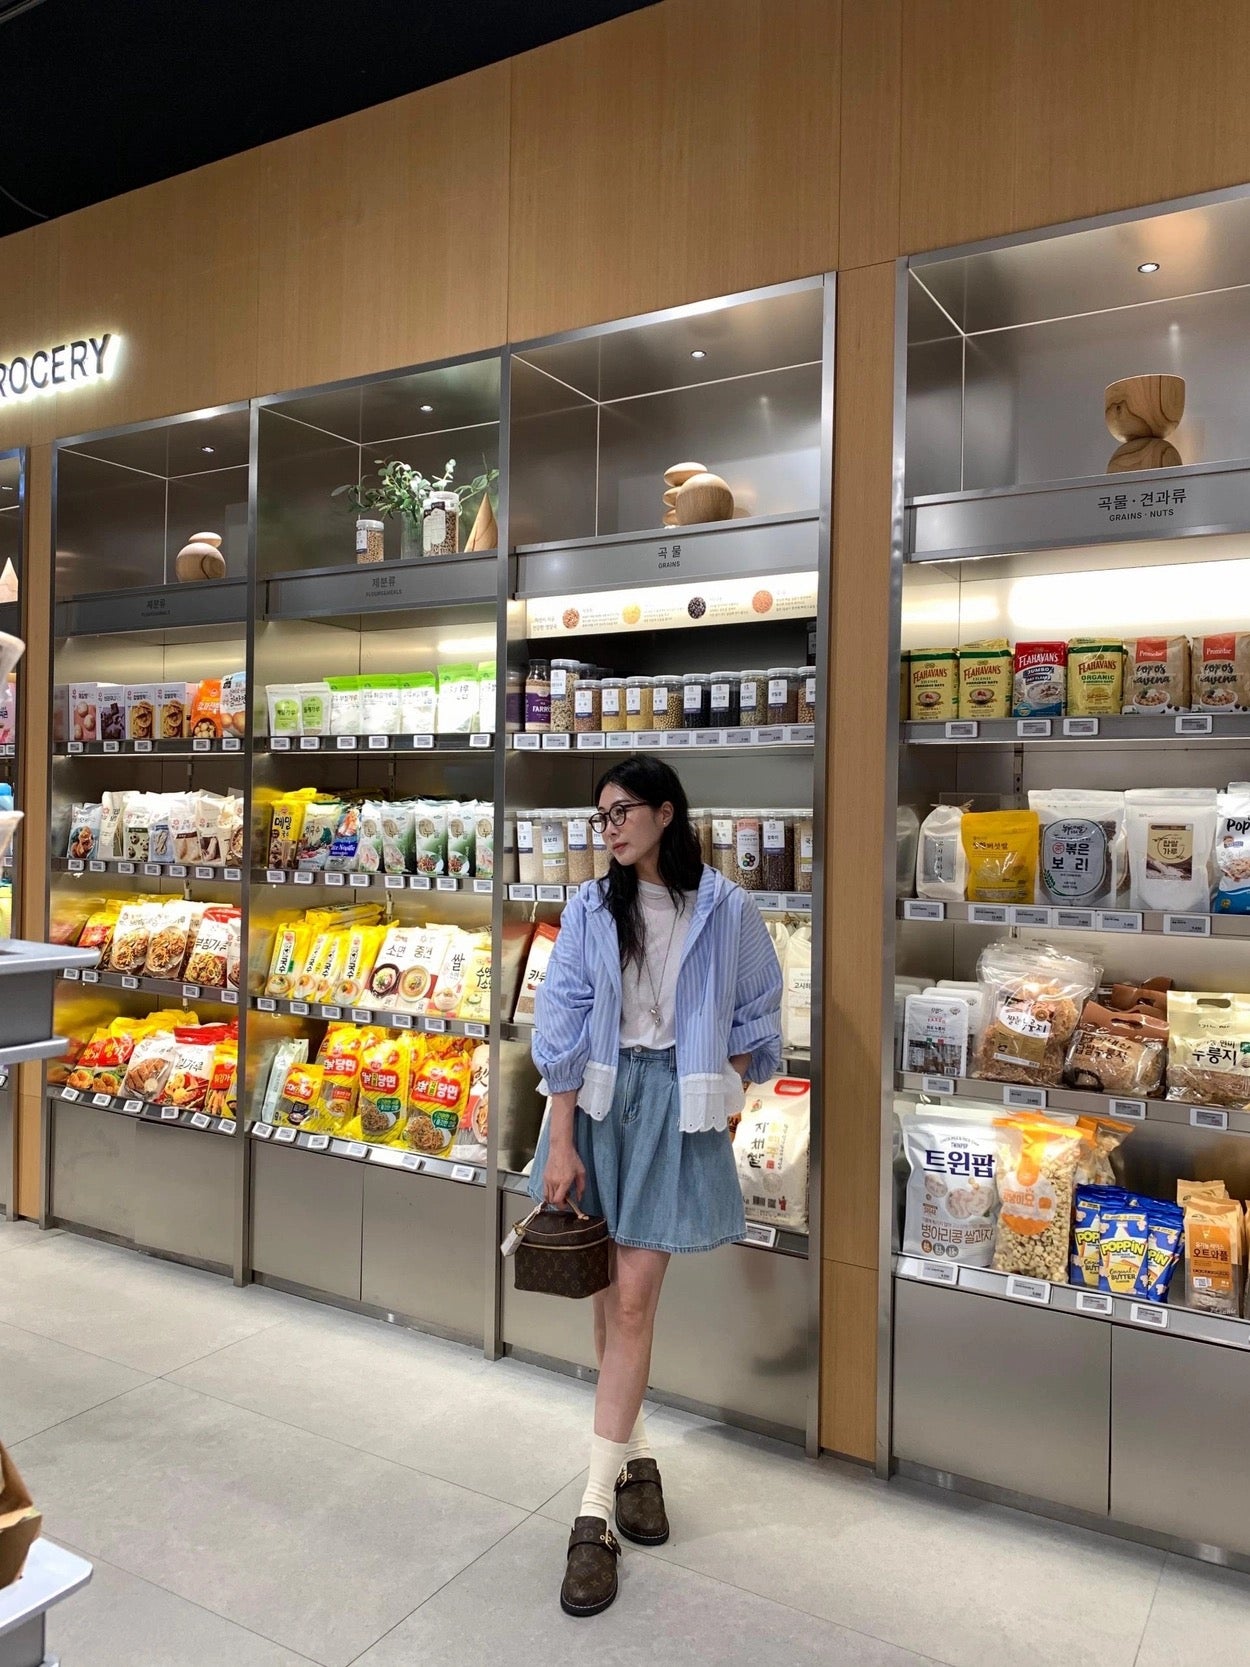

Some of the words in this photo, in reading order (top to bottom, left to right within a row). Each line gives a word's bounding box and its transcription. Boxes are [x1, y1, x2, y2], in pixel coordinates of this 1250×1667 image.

[1097, 494, 1128, 511] 곡물
[1140, 488, 1187, 507] 견과류
[1109, 512, 1142, 521] GRAINS
[1150, 509, 1174, 518] NUTS
[657, 544, 682, 559] 곡물
[657, 560, 681, 568] GRAINS
[1018, 652, 1059, 669] FLAHAVAN'S
[1078, 659, 1117, 675] FLAHAVAN'S
[963, 664, 1001, 681] FLAHAVAN'S
[1065, 842, 1091, 857] 볶은
[1162, 848, 1178, 856] 가루
[386, 943, 406, 958] 소면
[451, 953, 466, 972] 쌀
[1191, 1047, 1238, 1066] 누룽지
[923, 1149, 996, 1179] 트윈팝
[921, 1223, 963, 1244] 병아리콩
[964, 1228, 994, 1245] 쌀과자
[1147, 1248, 1171, 1267] PIN
